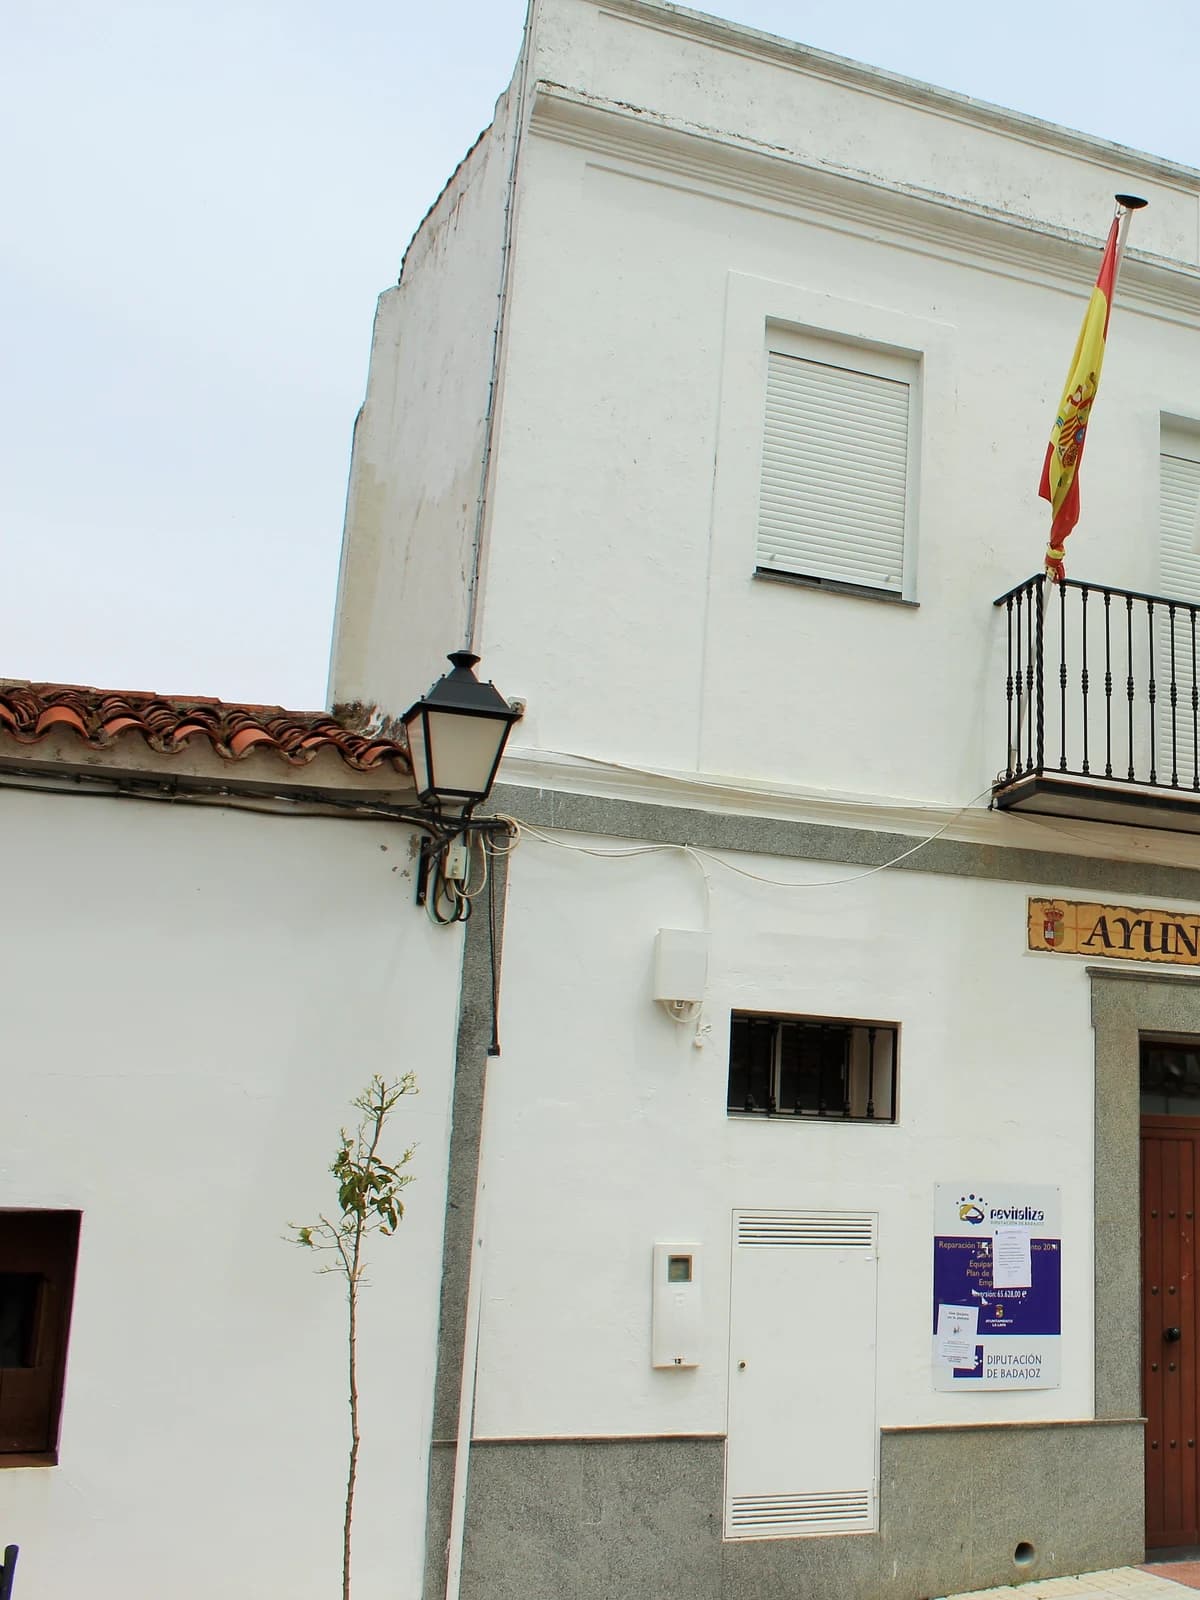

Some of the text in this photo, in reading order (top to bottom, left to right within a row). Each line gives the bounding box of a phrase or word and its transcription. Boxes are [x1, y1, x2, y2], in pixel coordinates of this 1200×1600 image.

[990, 1206, 1045, 1221] revitaliza
[938, 1240, 976, 1250] Reparación
[966, 1269, 990, 1277] Plan de
[987, 1354, 1042, 1365] DIPUTACIÓN
[986, 1368, 1041, 1380] DE BADAJOZ
